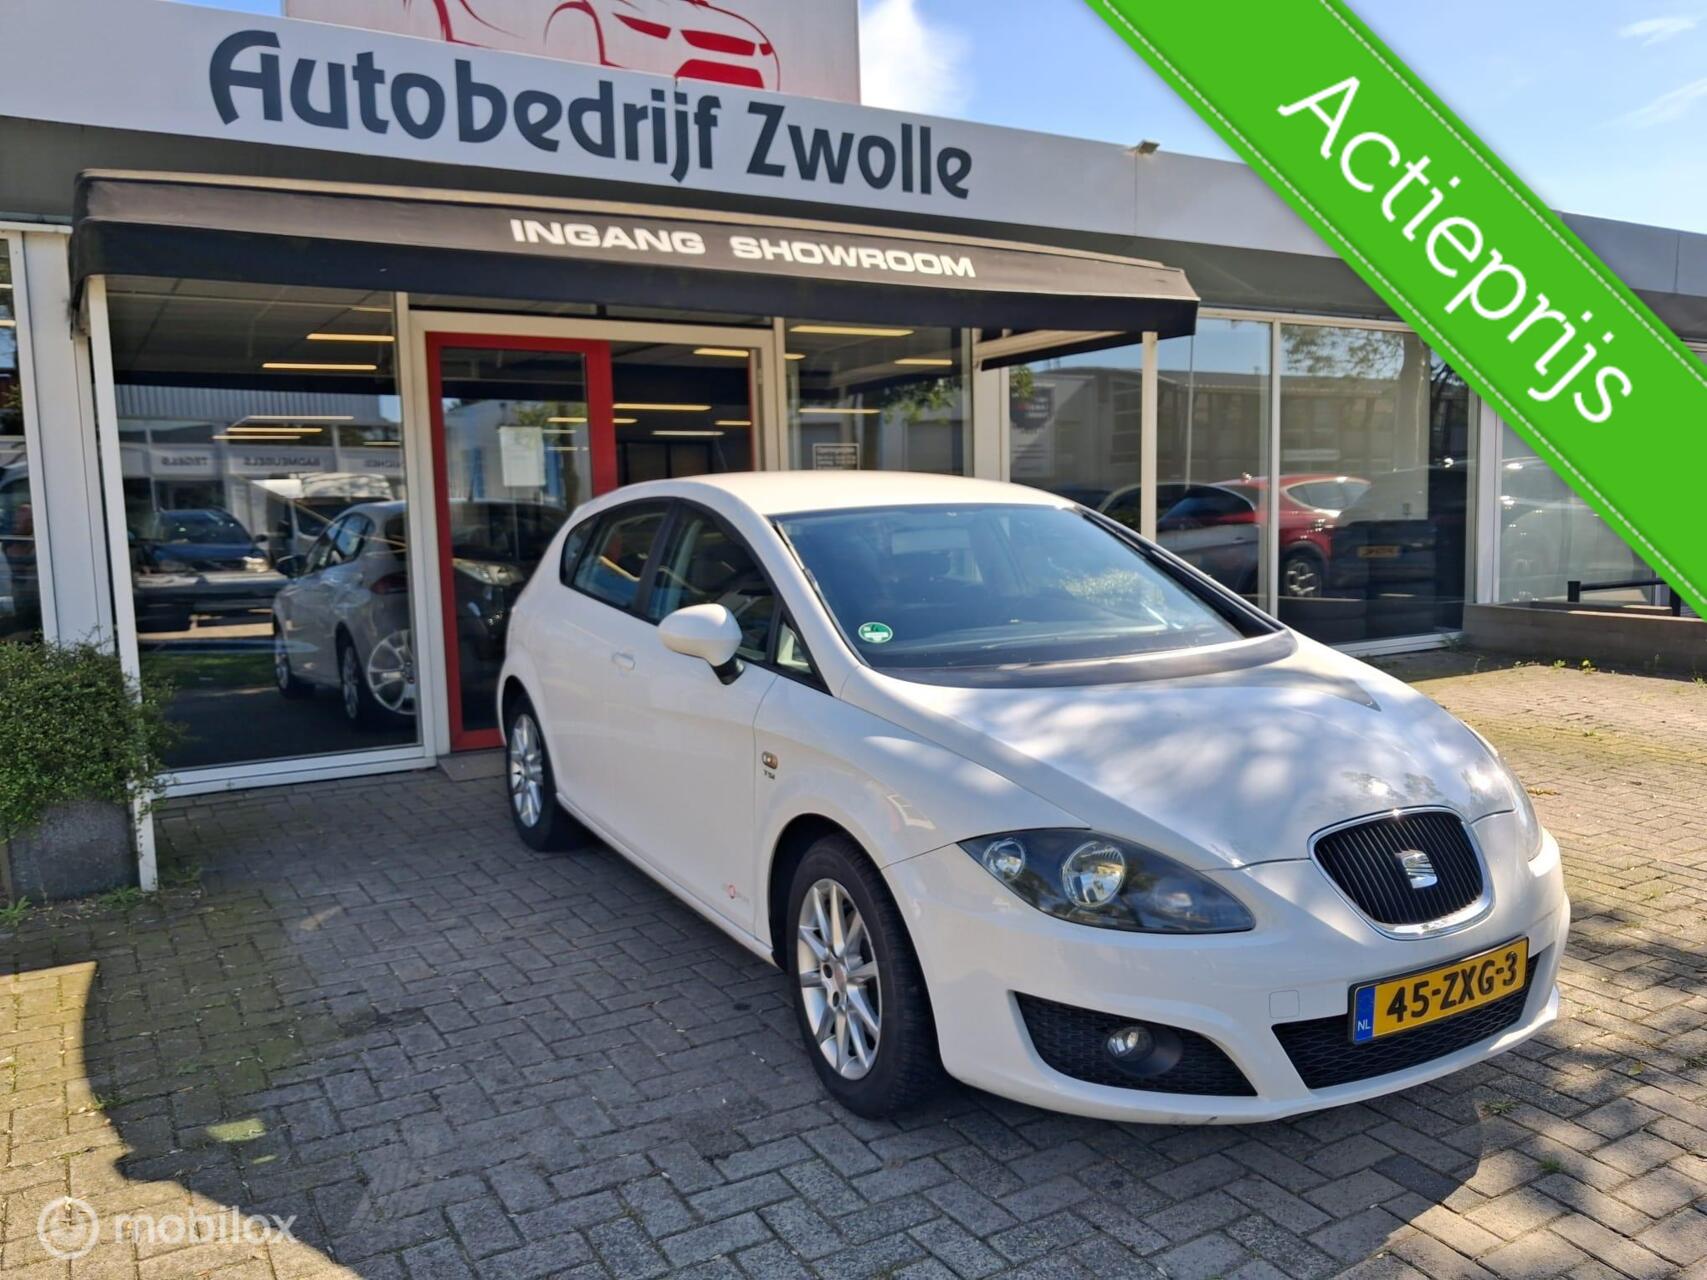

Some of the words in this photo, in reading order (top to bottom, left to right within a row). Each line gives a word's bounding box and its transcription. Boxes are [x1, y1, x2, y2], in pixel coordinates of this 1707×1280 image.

[209, 29, 721, 183] Autobedrijf
[746, 102, 973, 199] Zwolle
[510, 218, 705, 255] INGANG
[731, 235, 976, 278] SHOWROOM
[1386, 951, 1518, 1023] 45-ZXG-3
[1357, 1020, 1371, 1031] NL
